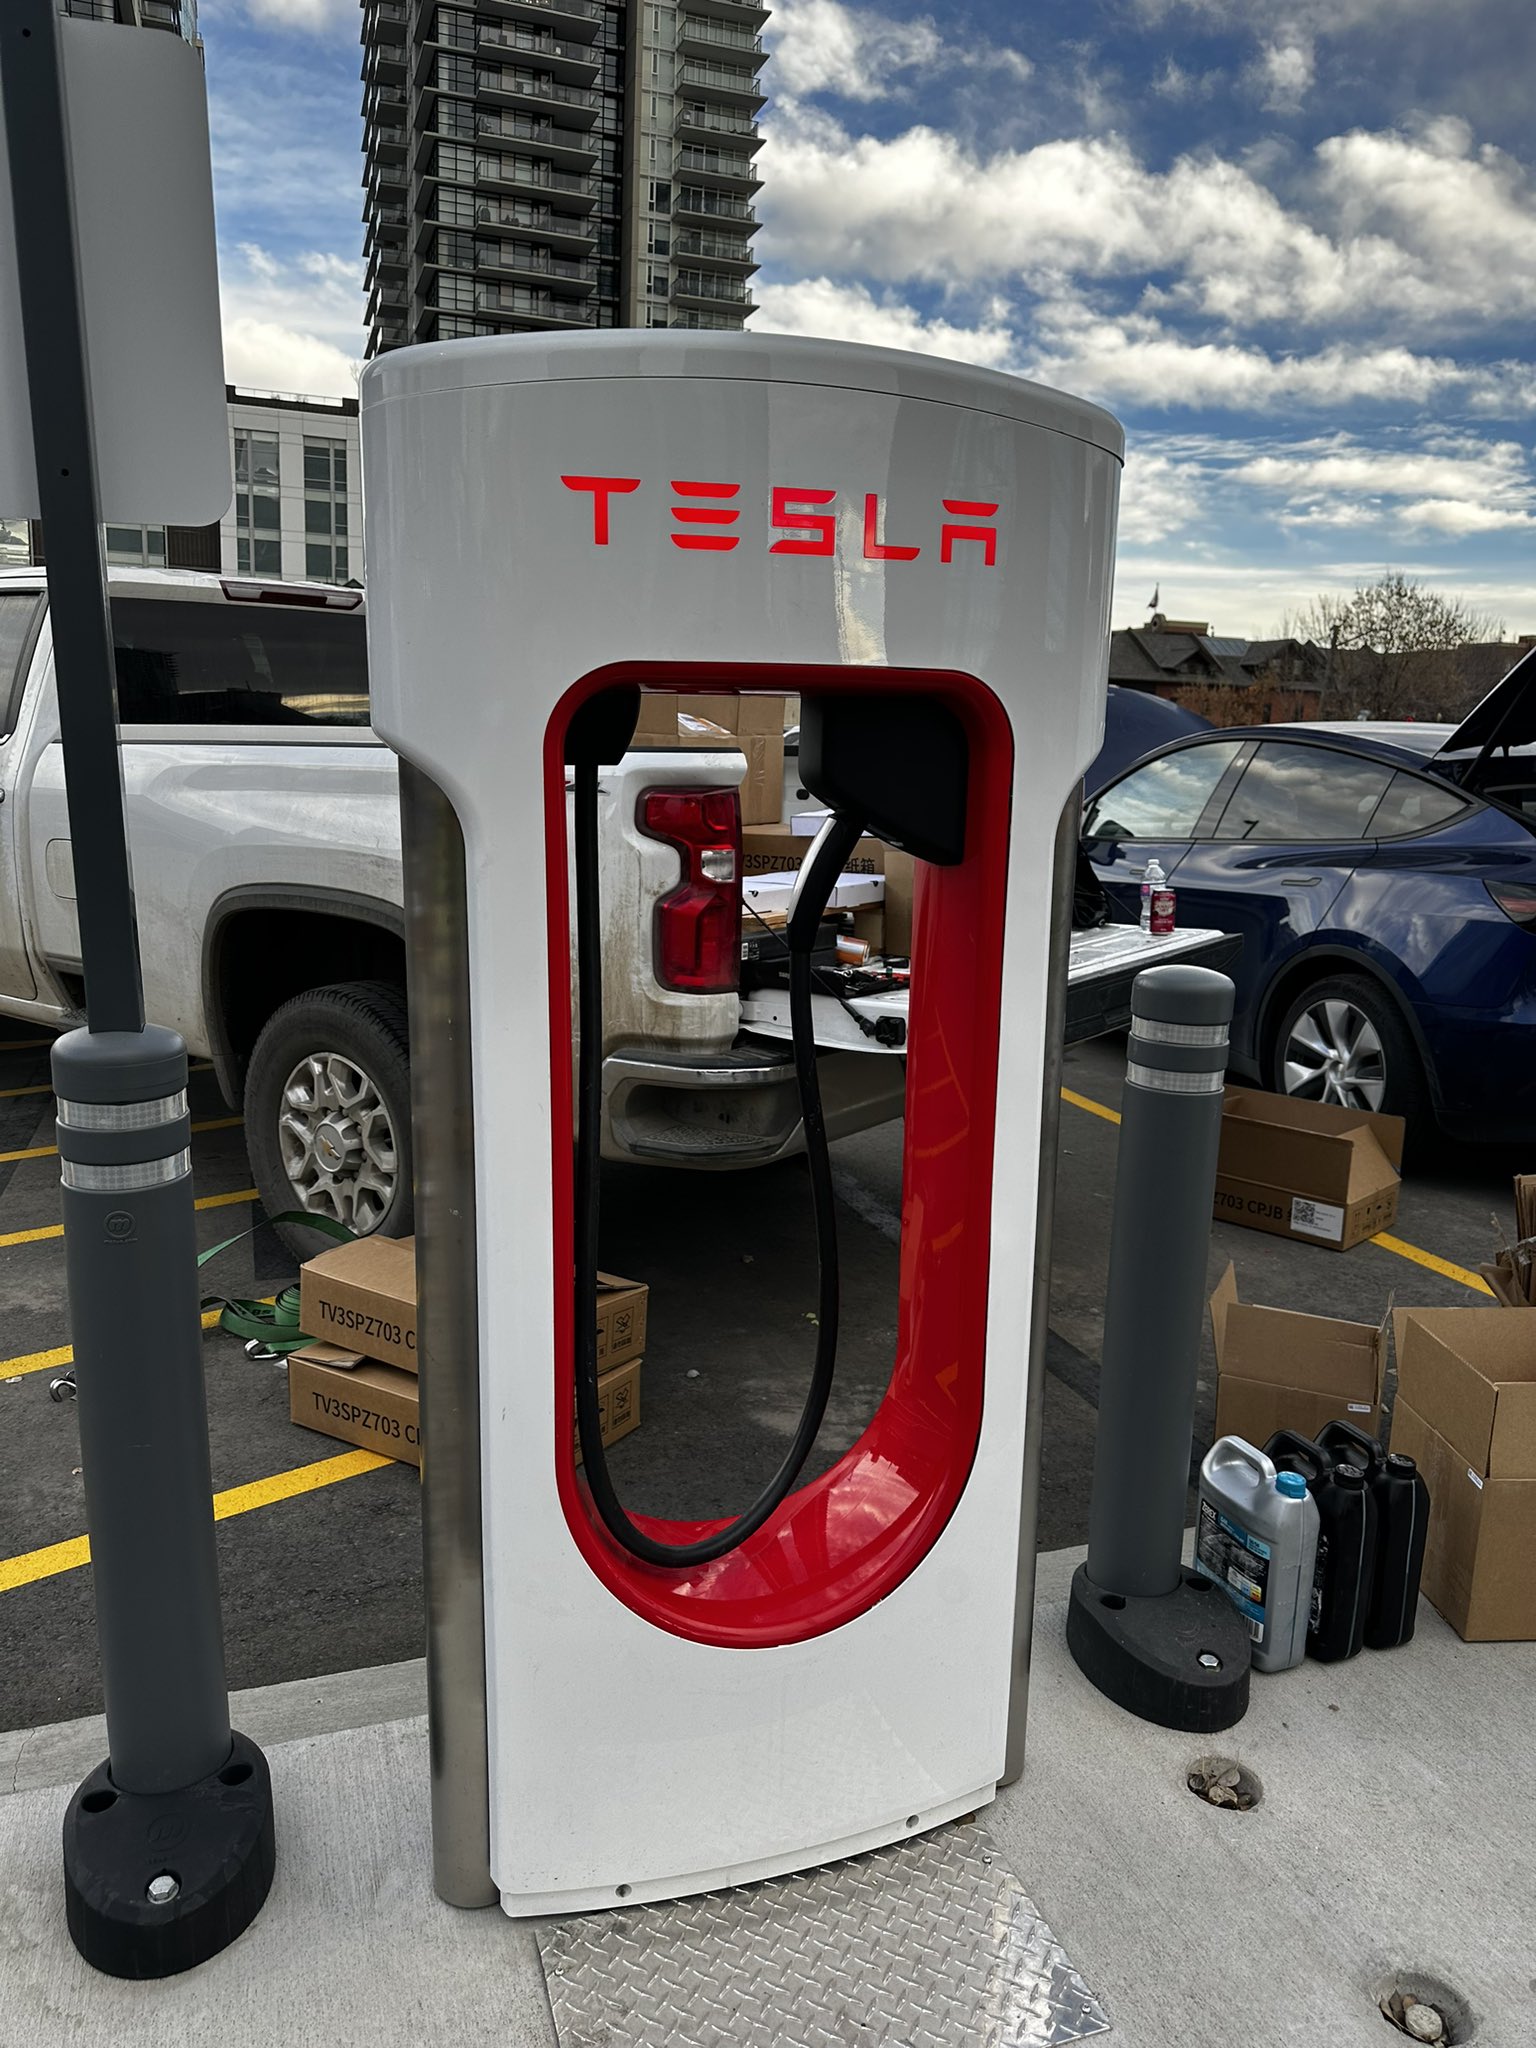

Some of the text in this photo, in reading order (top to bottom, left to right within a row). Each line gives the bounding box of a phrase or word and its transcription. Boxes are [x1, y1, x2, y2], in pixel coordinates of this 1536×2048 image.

[560, 475, 999, 566] TESLA
[1247, 1200, 1283, 1220] CPJB
[318, 1300, 401, 1344] TV3SPZ703
[312, 1391, 420, 1446] TV3SPZ703 C
